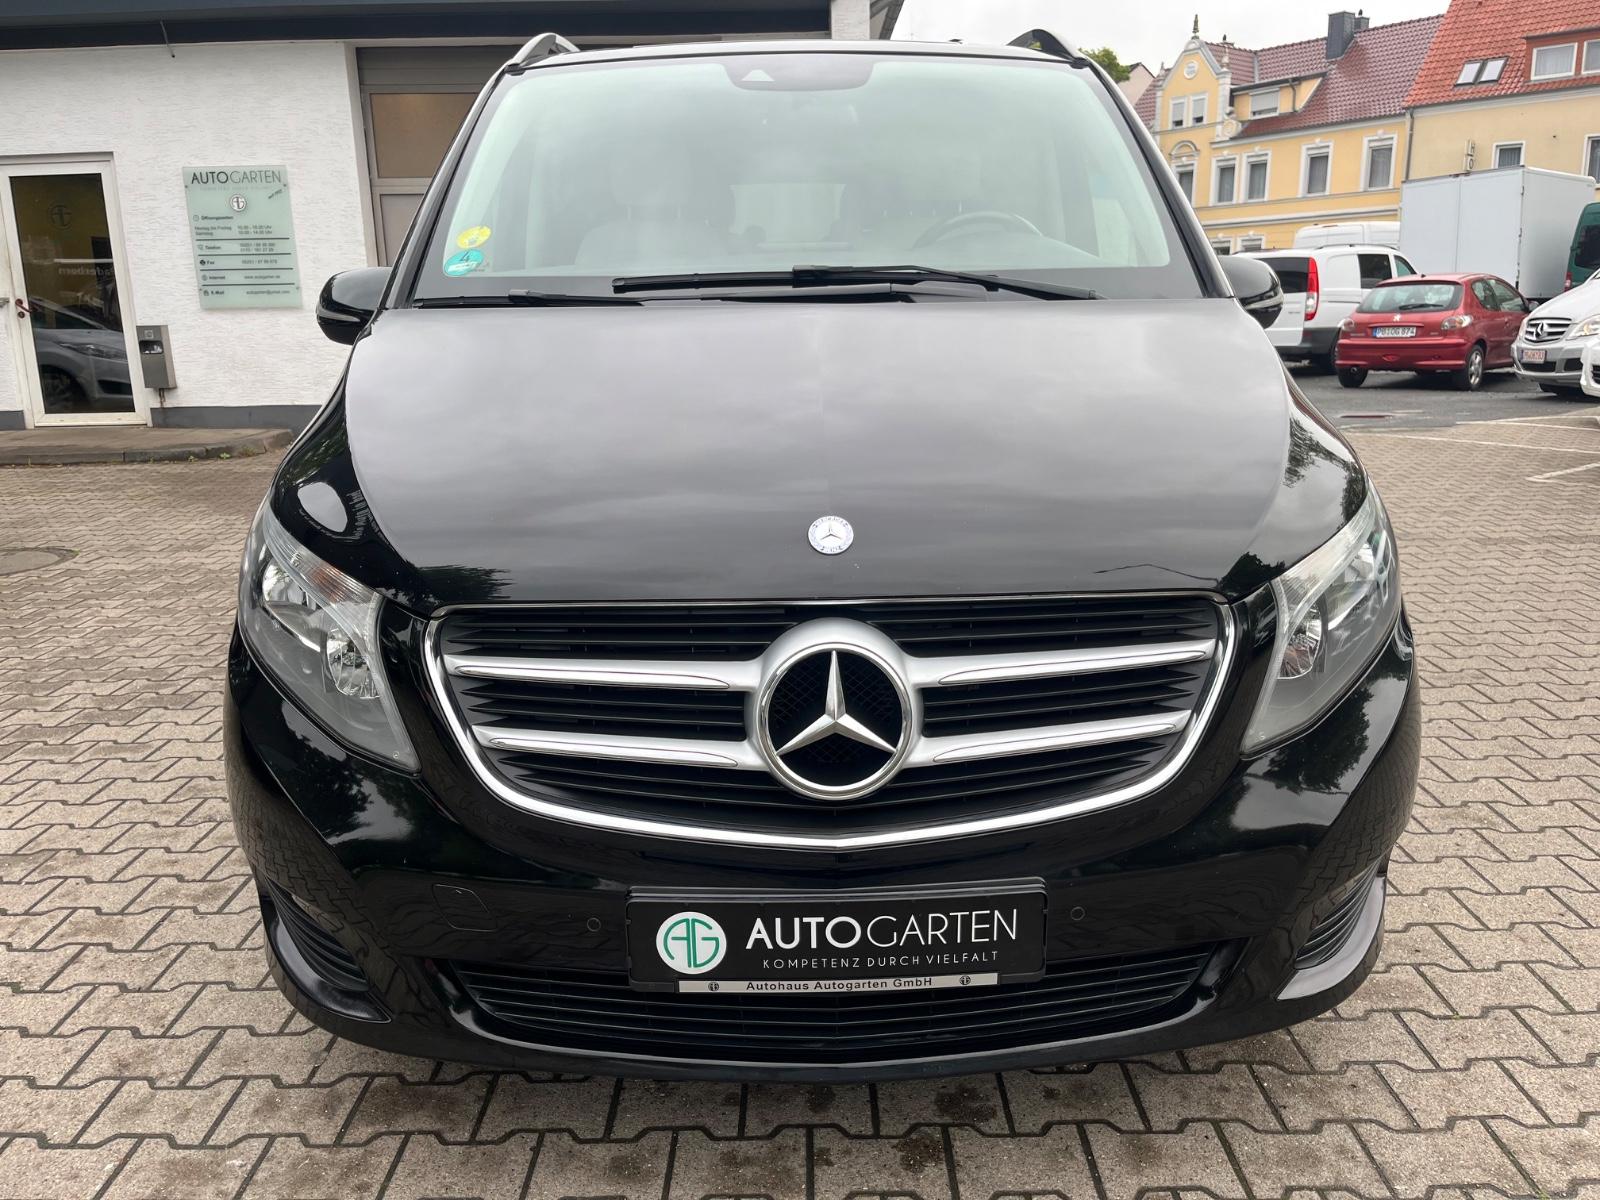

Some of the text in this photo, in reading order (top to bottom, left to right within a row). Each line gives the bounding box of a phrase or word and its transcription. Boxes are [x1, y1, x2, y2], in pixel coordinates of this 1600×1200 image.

[191, 170, 282, 185] AUTOGARTEN
[745, 908, 1018, 950] AUTOGARTEN
[763, 950, 999, 969] KOMPETENZ DURCH VIELFALT
[746, 977, 933, 991] Autohaus Autogarten GmbH
